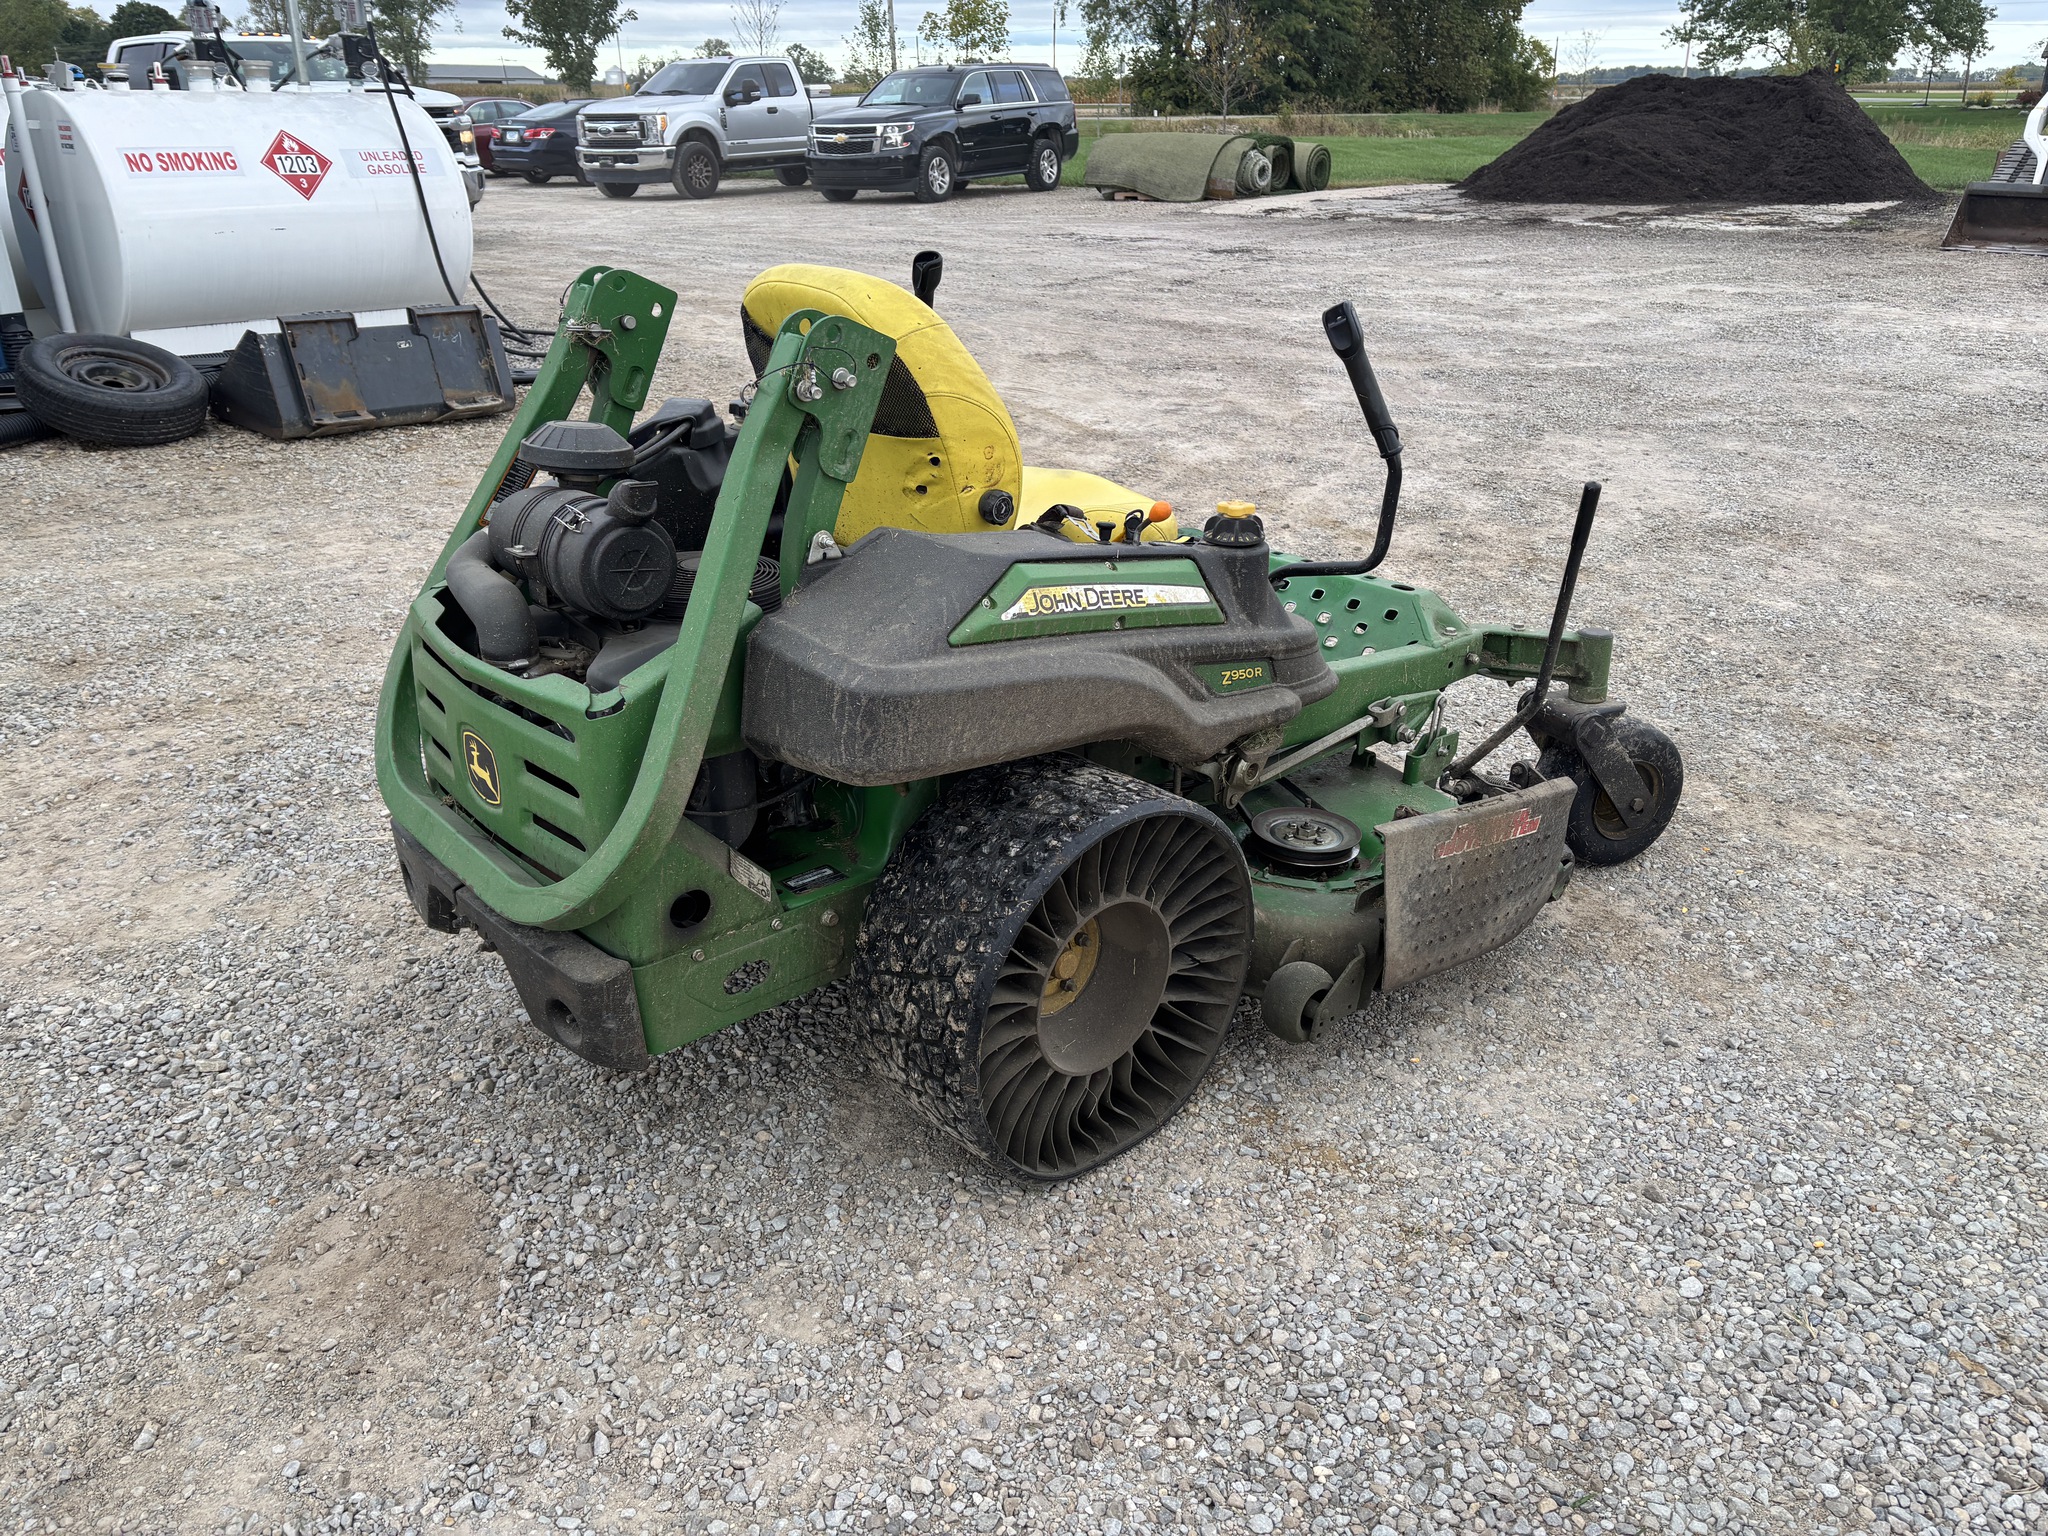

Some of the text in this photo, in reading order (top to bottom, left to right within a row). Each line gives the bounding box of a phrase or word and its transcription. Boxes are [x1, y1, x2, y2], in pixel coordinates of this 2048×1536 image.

[123, 151, 238, 172] NO SMOKING
[277, 155, 318, 174] 1203
[358, 150, 423, 162] UNLEADD
[367, 163, 427, 175] GASOLIE
[299, 177, 308, 189] 3
[1030, 586, 1146, 613] JOHN DEERE
[1221, 667, 1262, 685] Z950R
